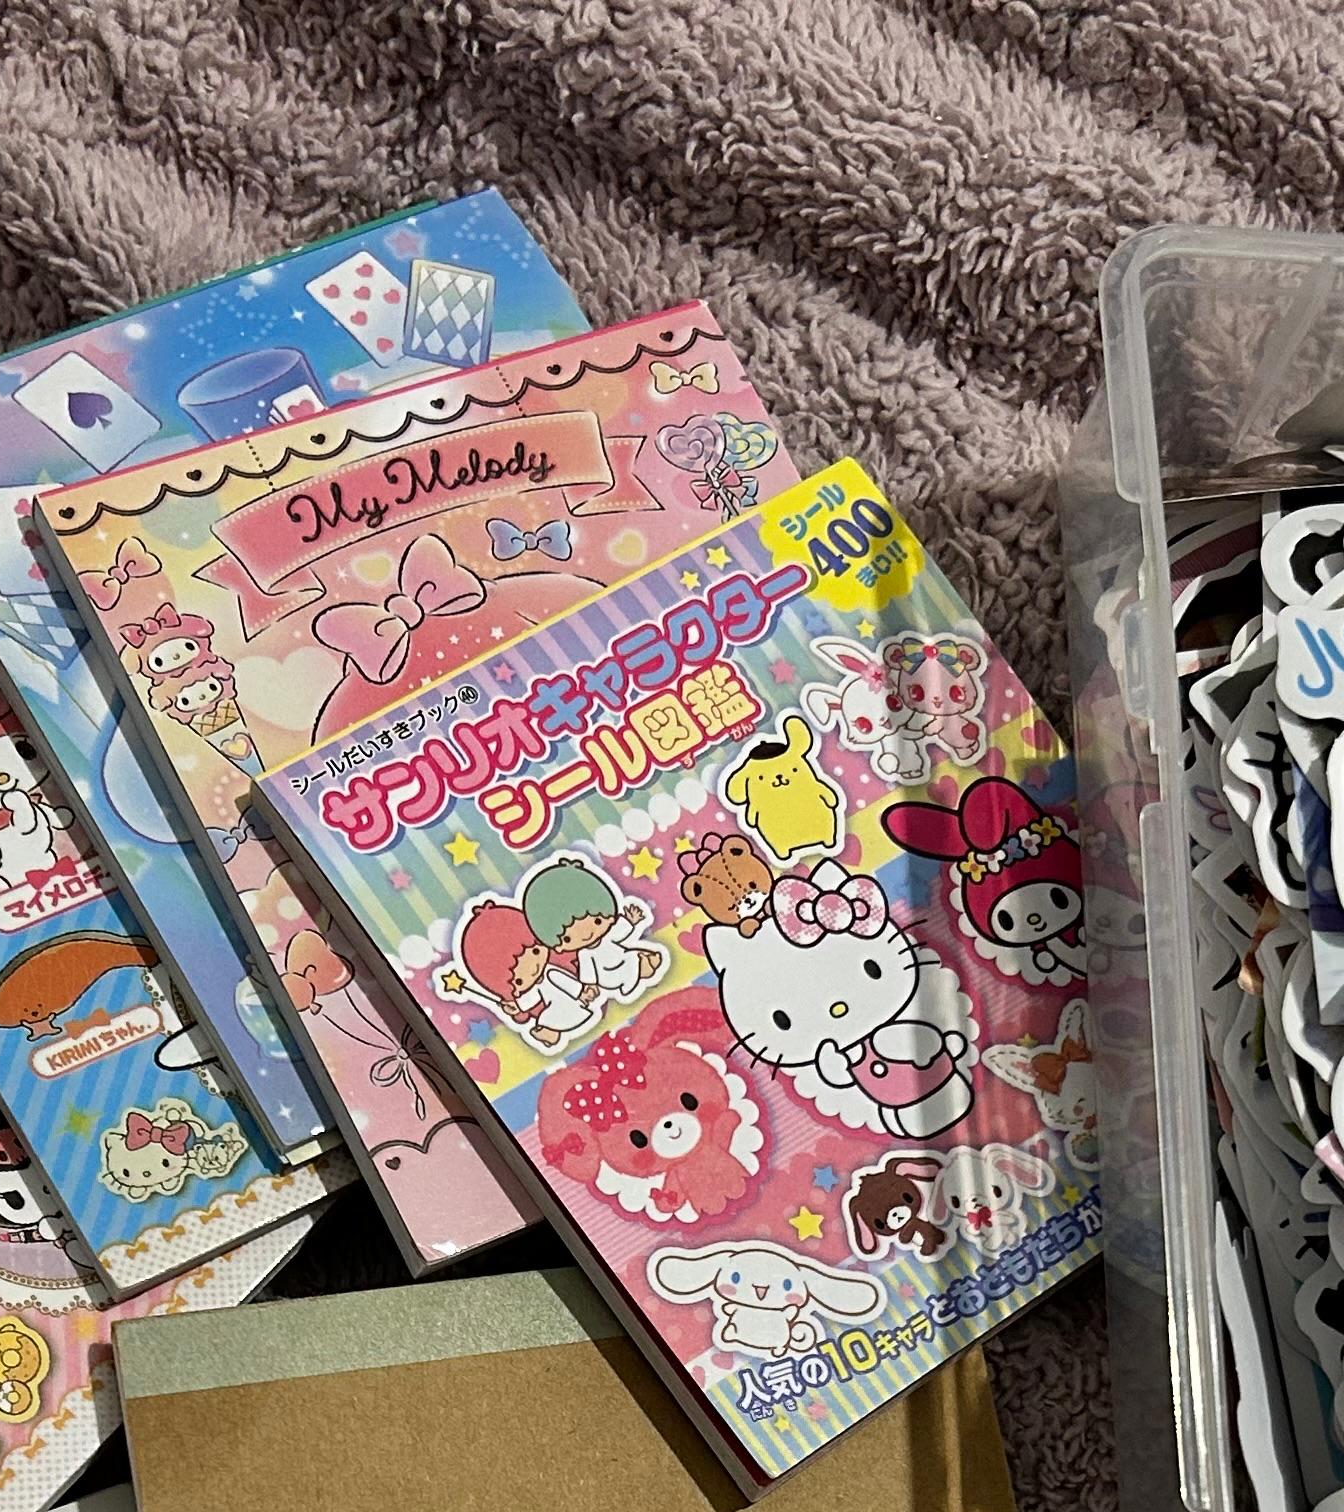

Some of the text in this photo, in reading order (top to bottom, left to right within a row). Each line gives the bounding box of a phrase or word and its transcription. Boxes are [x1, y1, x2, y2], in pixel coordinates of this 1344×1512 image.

[286, 440, 557, 542] My Melody
[779, 482, 846, 541] シール
[807, 499, 894, 578] 400
[321, 563, 808, 851] サンリオキャラクター
[478, 660, 763, 849] シール図鑑
